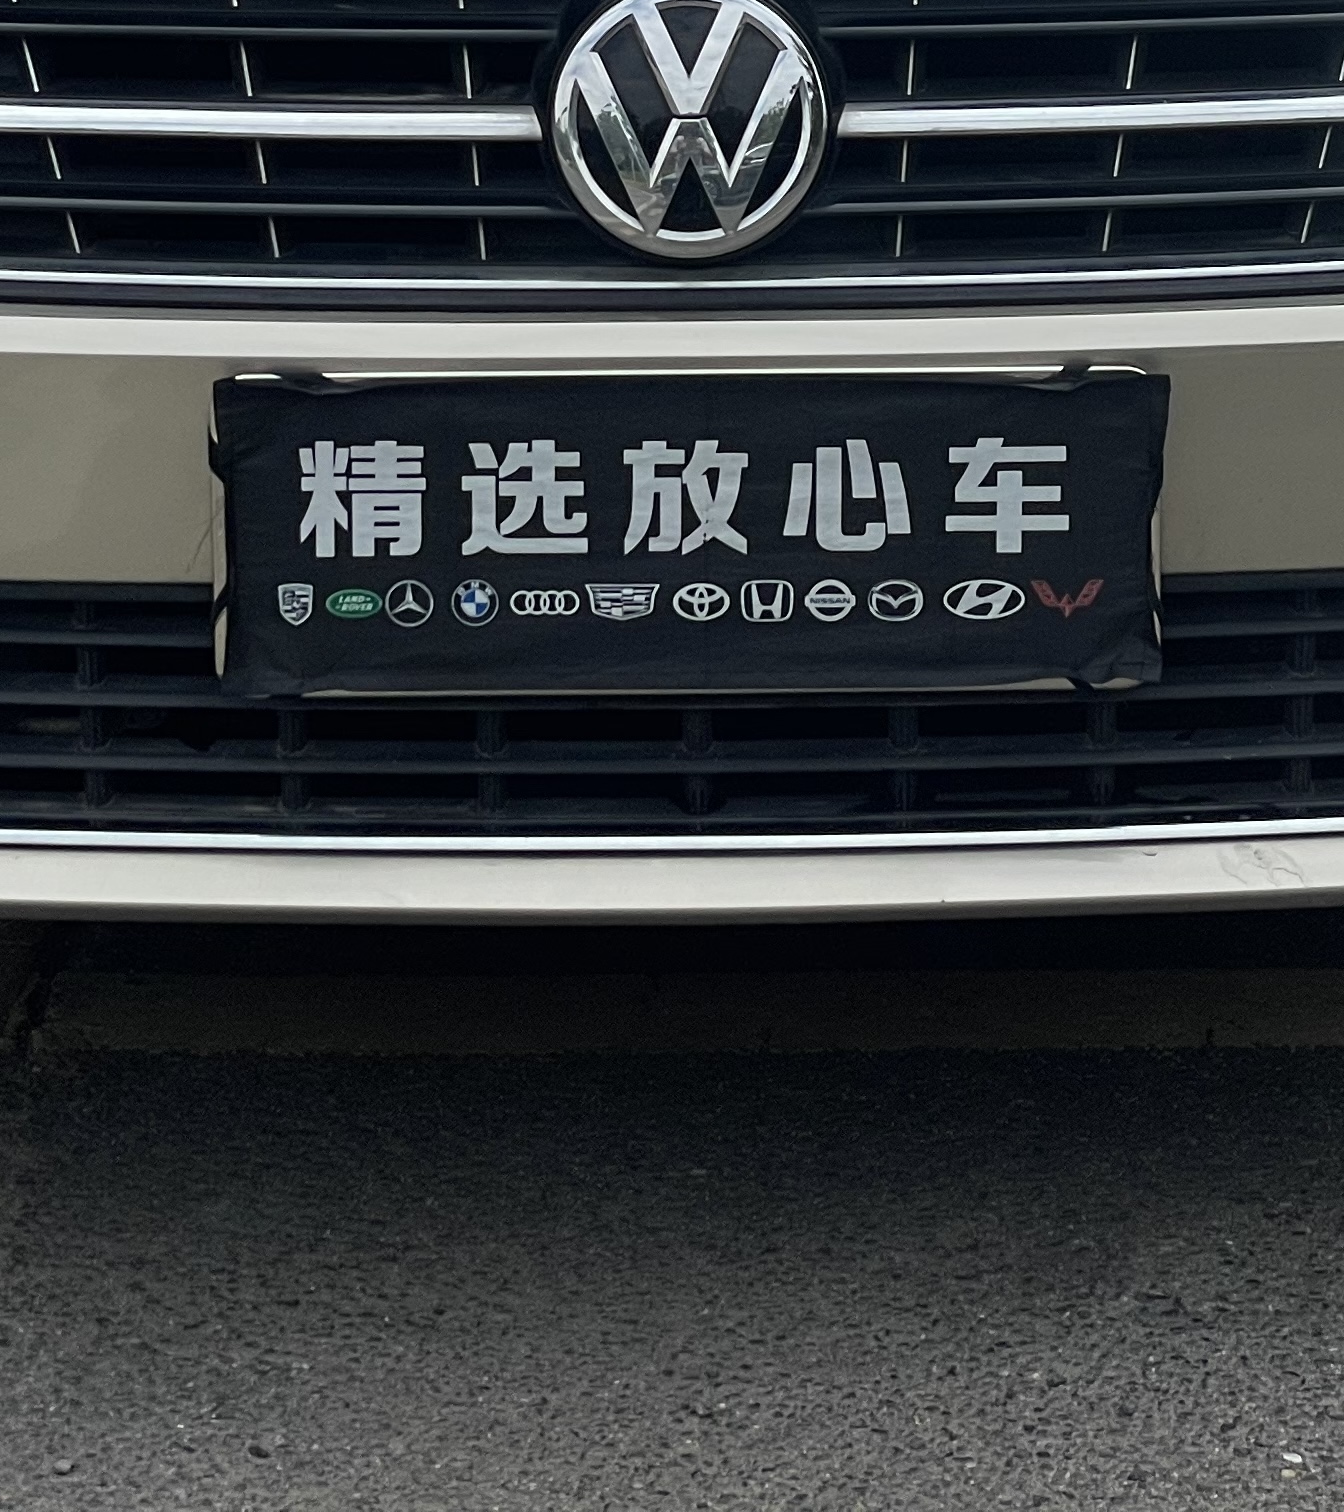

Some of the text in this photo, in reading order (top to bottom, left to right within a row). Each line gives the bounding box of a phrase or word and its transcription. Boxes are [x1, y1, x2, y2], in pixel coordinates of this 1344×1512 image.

[299, 437, 1070, 557] 精选放心车
